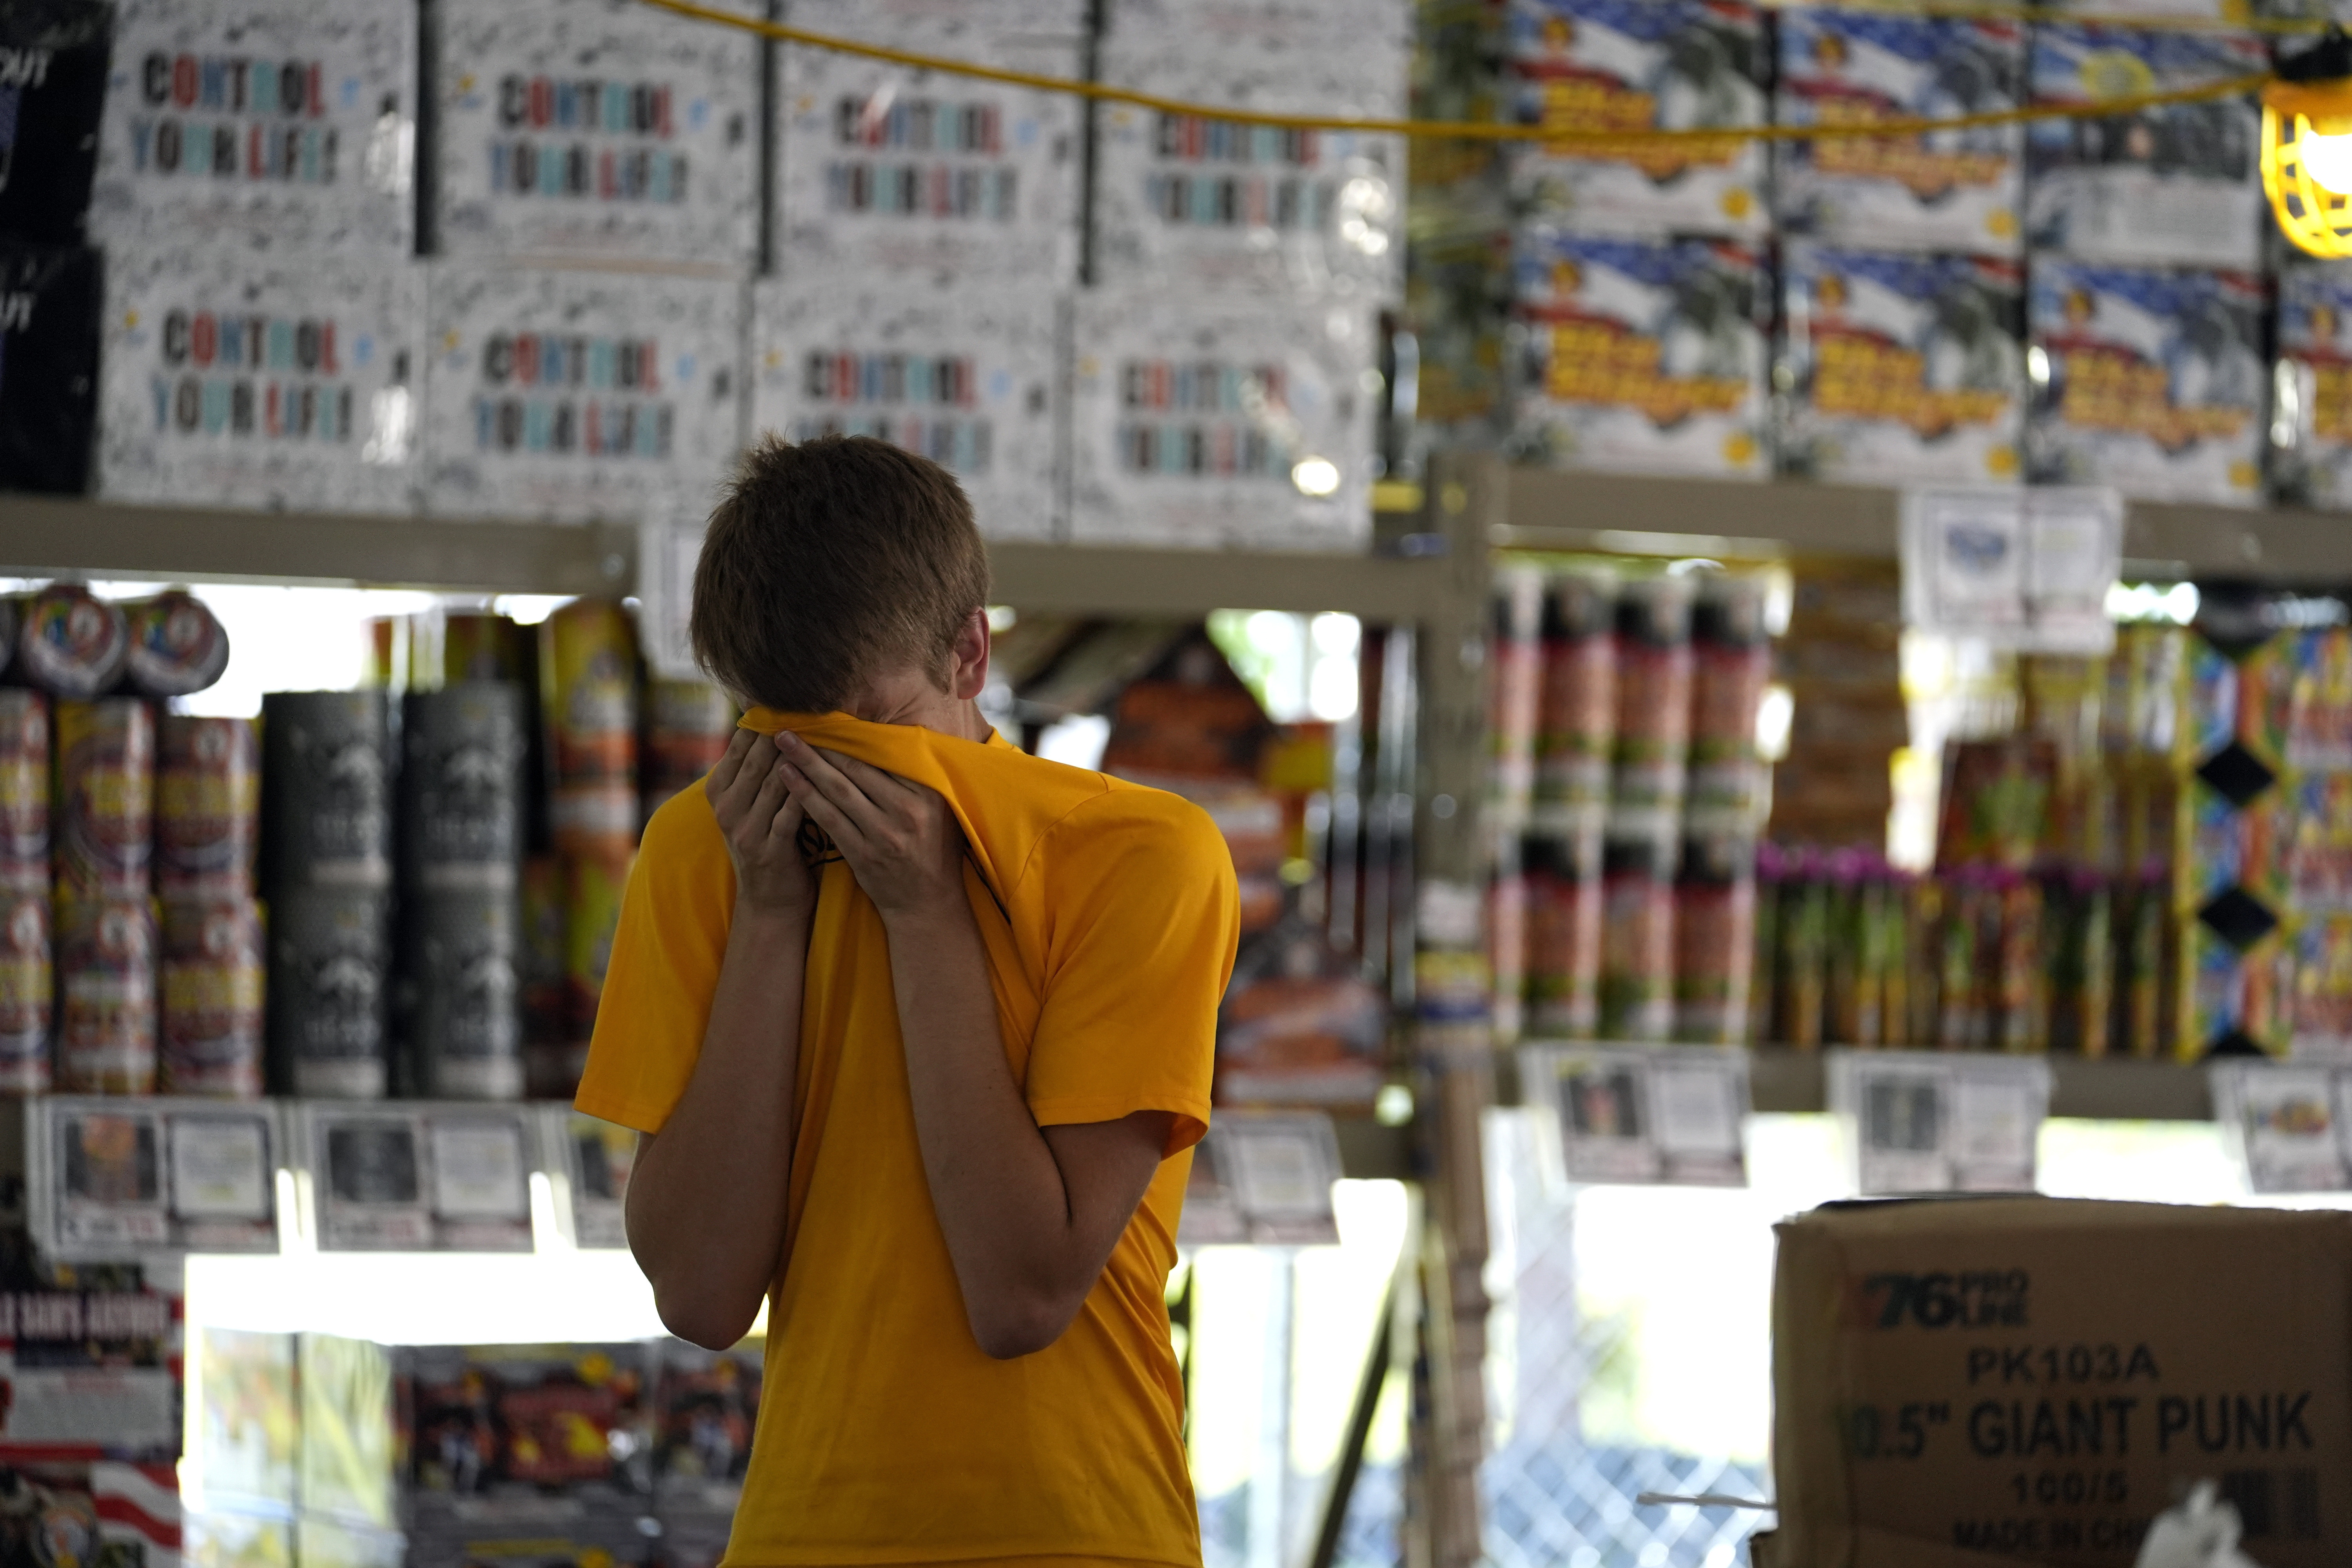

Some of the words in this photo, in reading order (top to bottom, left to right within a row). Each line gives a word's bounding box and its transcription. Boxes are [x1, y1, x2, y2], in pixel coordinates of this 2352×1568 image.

[1862, 1272, 1958, 1329] 76
[1959, 1266, 2031, 1295] PRO
[1959, 1296, 2030, 1328] LINE
[1966, 1342, 2161, 1386] PK103A
[1968, 1396, 2138, 1458] GIANT
[2157, 1390, 2315, 1454] PUNK
[1953, 1517, 2042, 1552] MADE
[2049, 1518, 2082, 1550] IN
[2091, 1515, 2154, 1550] CHI
